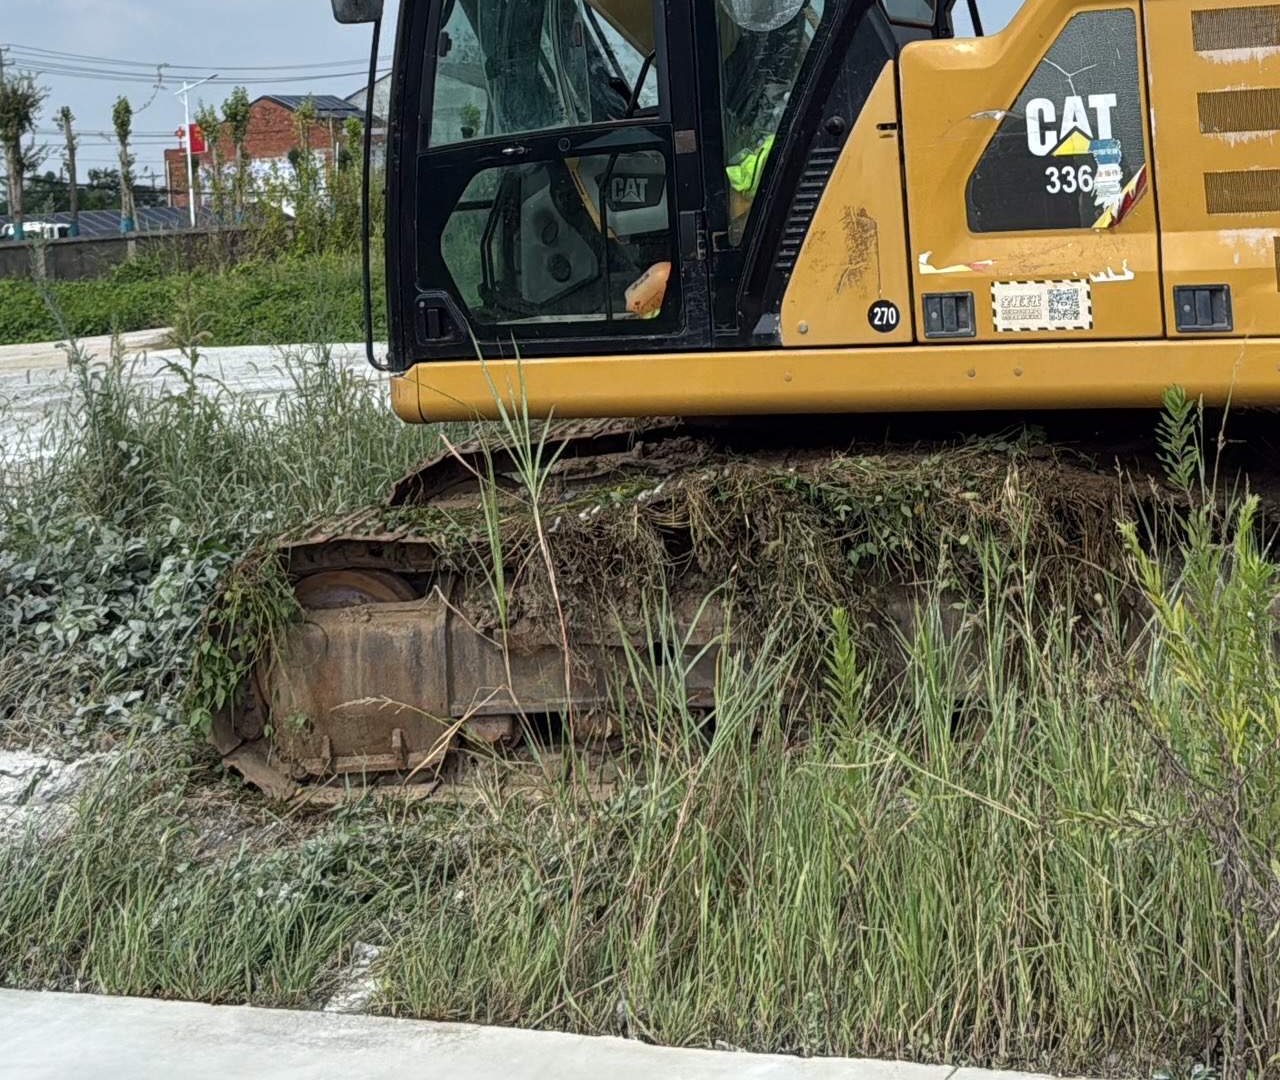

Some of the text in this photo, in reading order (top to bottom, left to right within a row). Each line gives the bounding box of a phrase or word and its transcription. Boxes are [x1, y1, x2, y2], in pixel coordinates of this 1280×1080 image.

[1025, 93, 1117, 156] CAT
[611, 177, 648, 203] CAT
[1045, 165, 1094, 194] 336
[873, 306, 897, 325] 270
